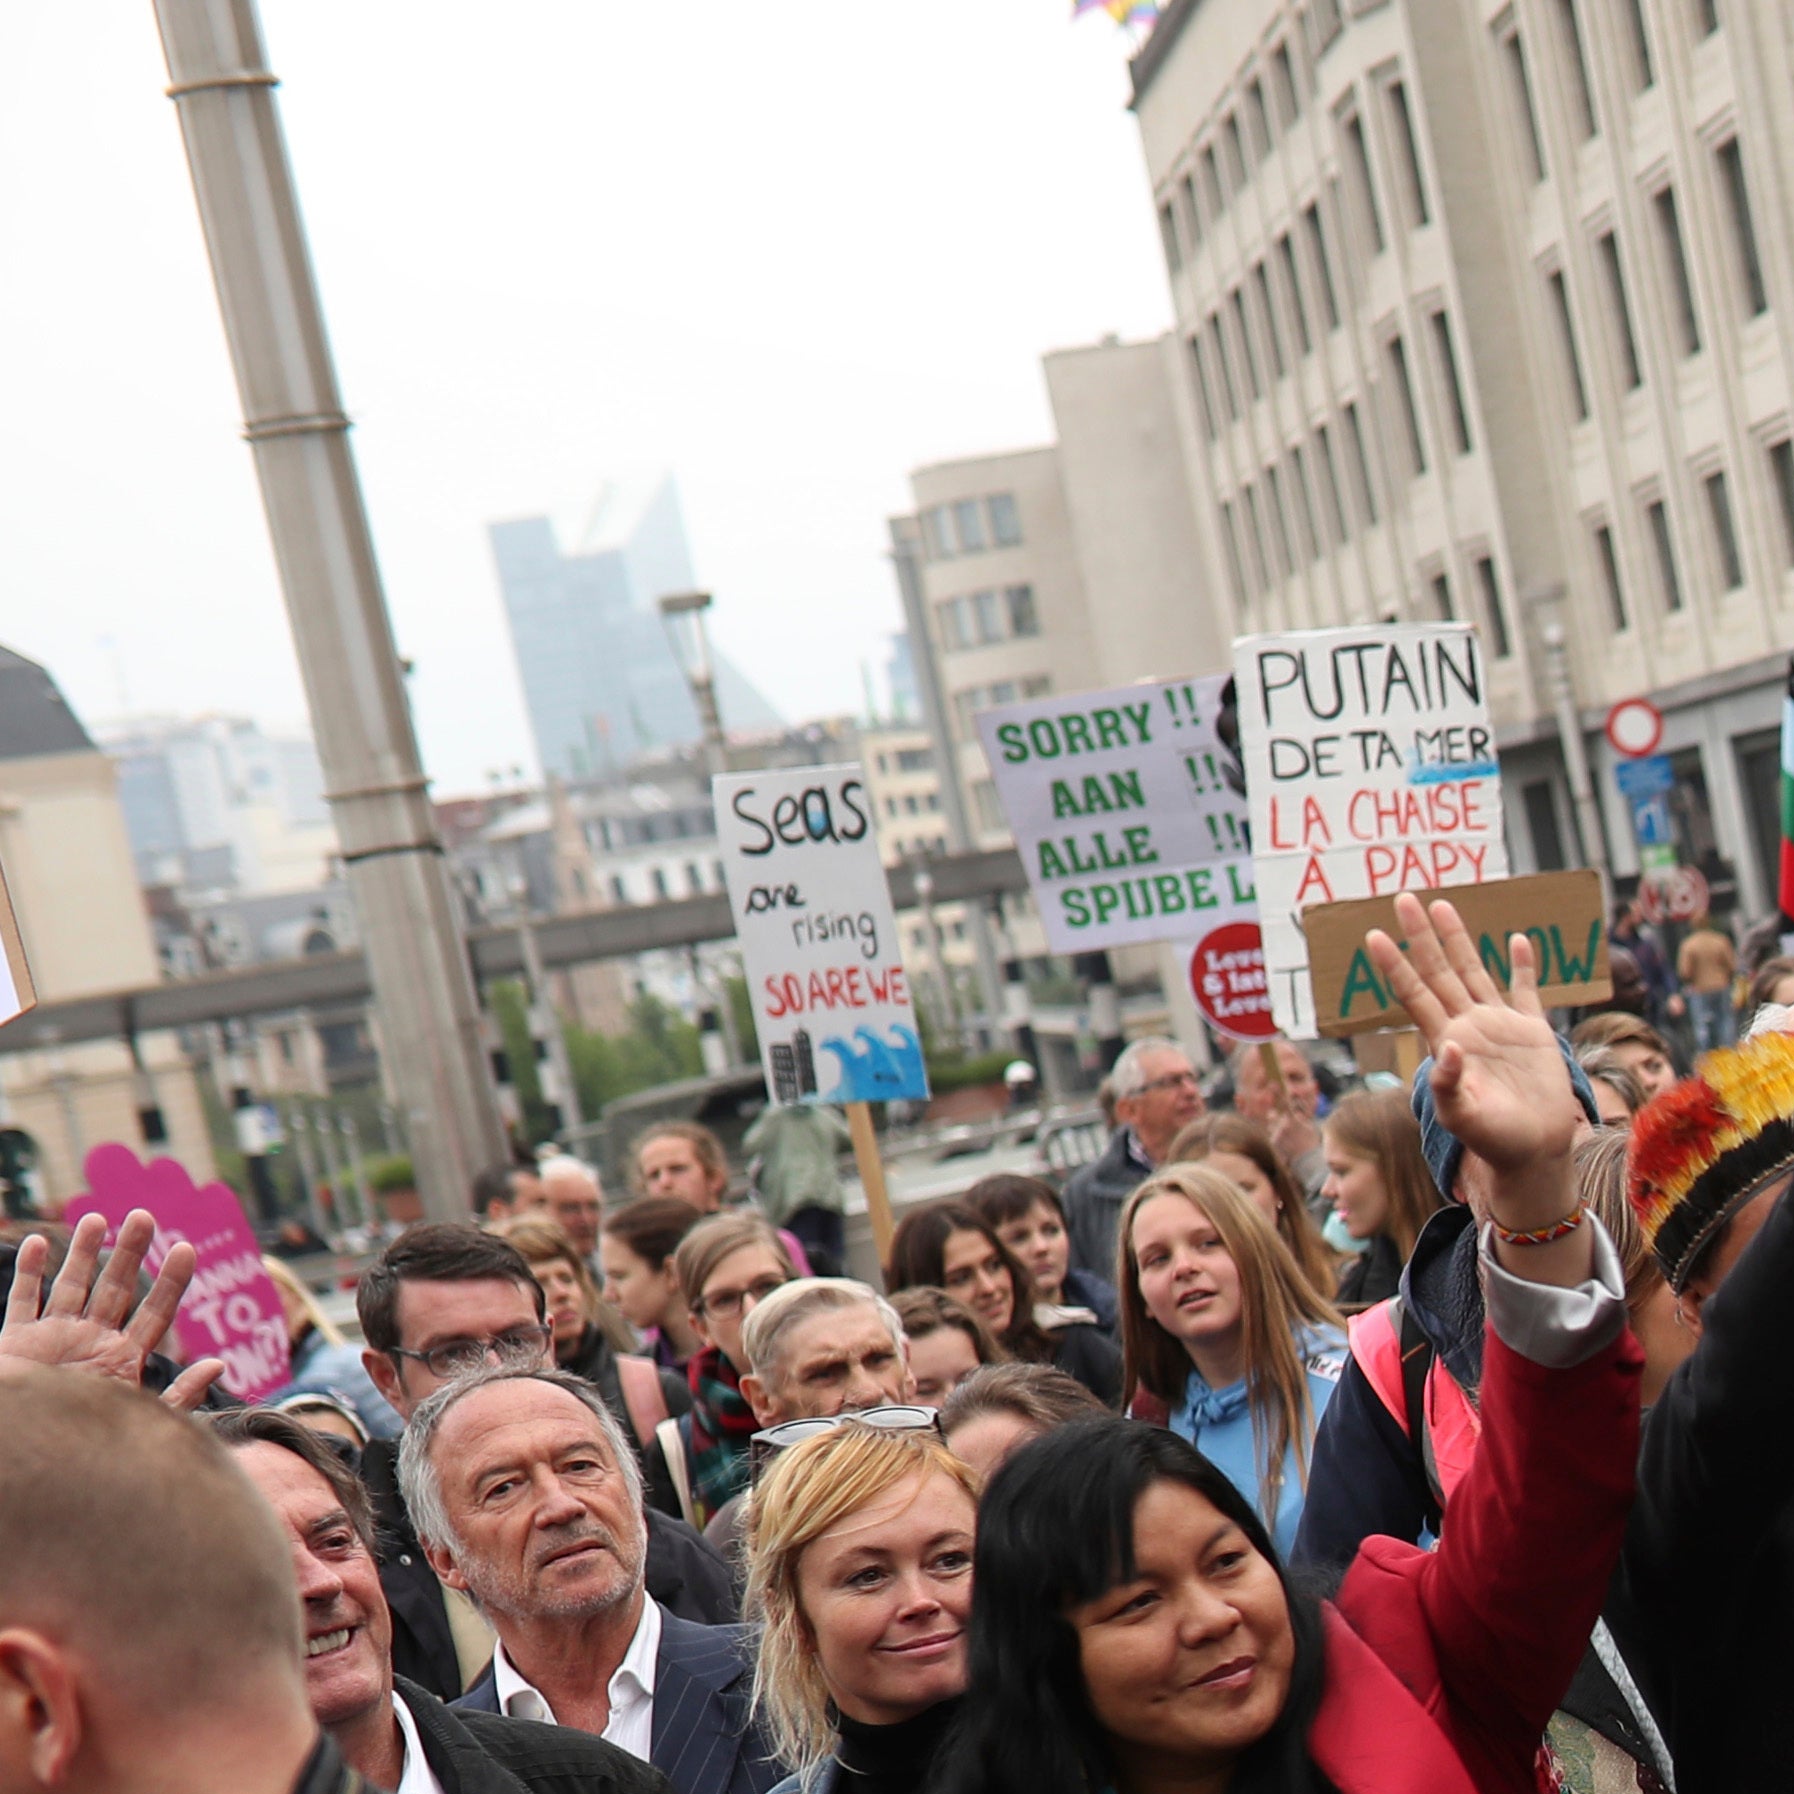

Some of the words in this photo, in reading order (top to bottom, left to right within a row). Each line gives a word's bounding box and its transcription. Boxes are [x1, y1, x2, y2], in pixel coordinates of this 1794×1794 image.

[1257, 635, 1481, 727] PUTAIN
[996, 701, 1154, 763] SORRY
[1269, 735, 1343, 782] DE
[1348, 730, 1403, 772] TA
[1414, 726, 1490, 768] MER
[732, 781, 869, 855] Seas
[1051, 768, 1148, 819] AAN
[1270, 794, 1332, 849] LA
[1348, 780, 1488, 841] CHAISE
[1036, 825, 1160, 881] ALLE
[1296, 843, 1334, 902] À
[1363, 840, 1487, 896] PAPY
[745, 880, 806, 915] are
[792, 910, 880, 960] rising
[764, 973, 803, 1019] SO
[807, 967, 867, 1013] ARE
[865, 966, 909, 1006] WE
[189, 1291, 261, 1347] TO
